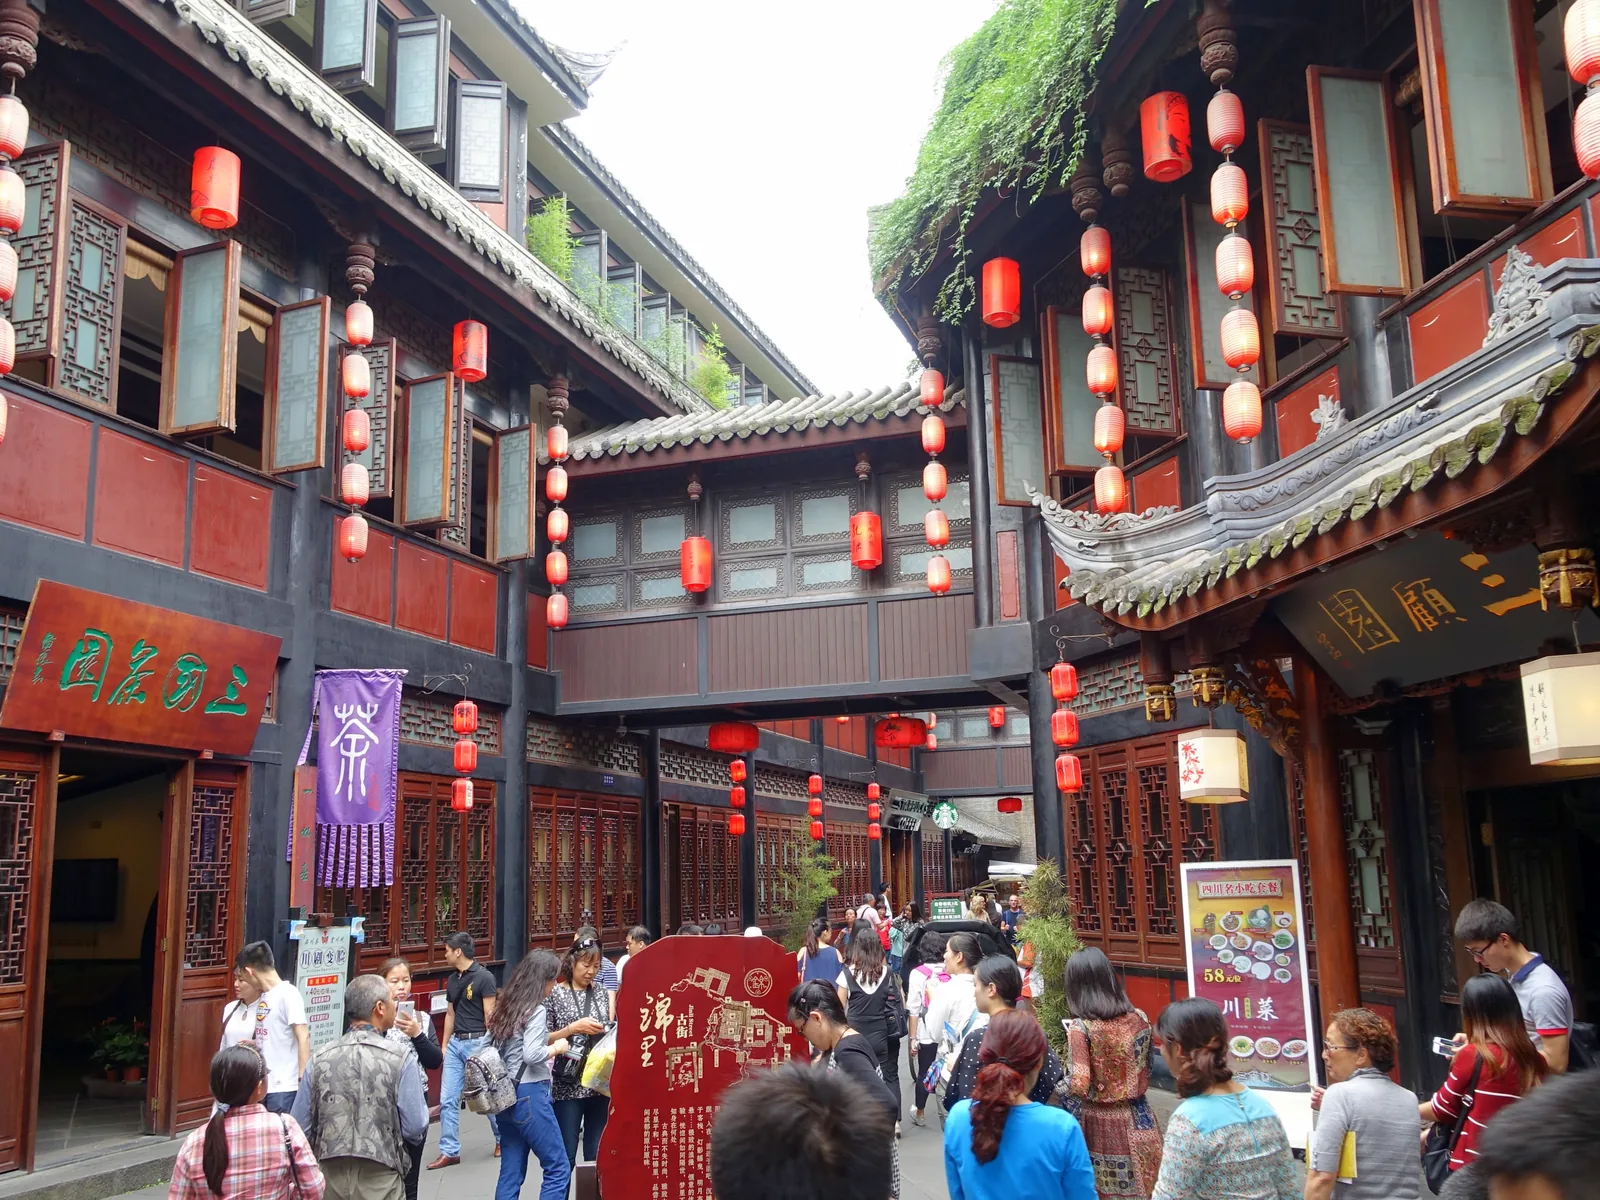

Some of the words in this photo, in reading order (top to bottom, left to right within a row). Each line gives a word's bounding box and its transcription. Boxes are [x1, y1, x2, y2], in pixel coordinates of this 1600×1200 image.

[1201, 881, 1279, 895] 四川名小吃套餐
[301, 950, 346, 966] 川剧变脸
[676, 1013, 688, 1039] 古街
